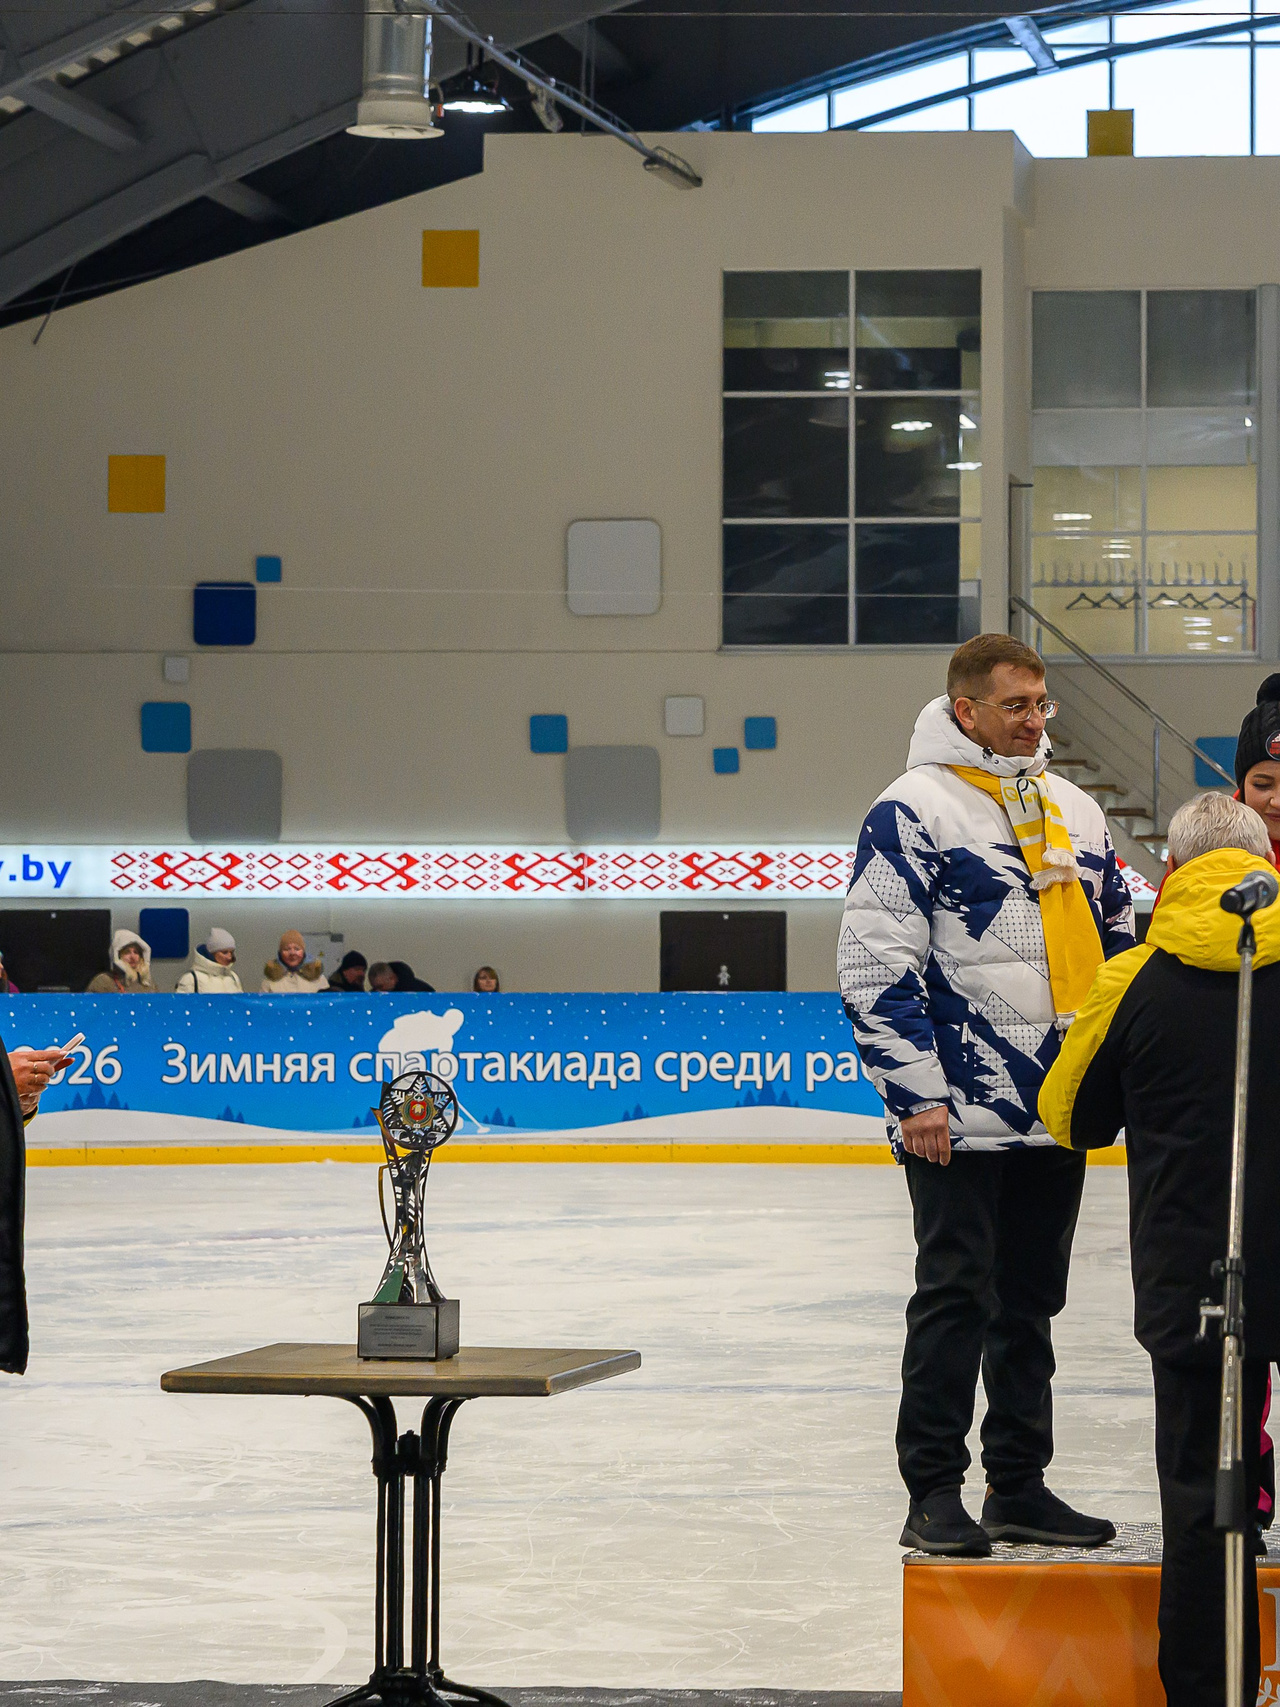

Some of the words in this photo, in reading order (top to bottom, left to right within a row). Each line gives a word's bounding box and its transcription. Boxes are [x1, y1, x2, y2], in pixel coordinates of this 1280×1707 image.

[0, 853, 72, 889] .by
[13, 1044, 122, 1086] 26
[162, 1042, 336, 1084] Зимняя
[349, 1051, 642, 1090] спартакиада
[654, 1051, 791, 1092] среди
[805, 1051, 876, 1093] ра
